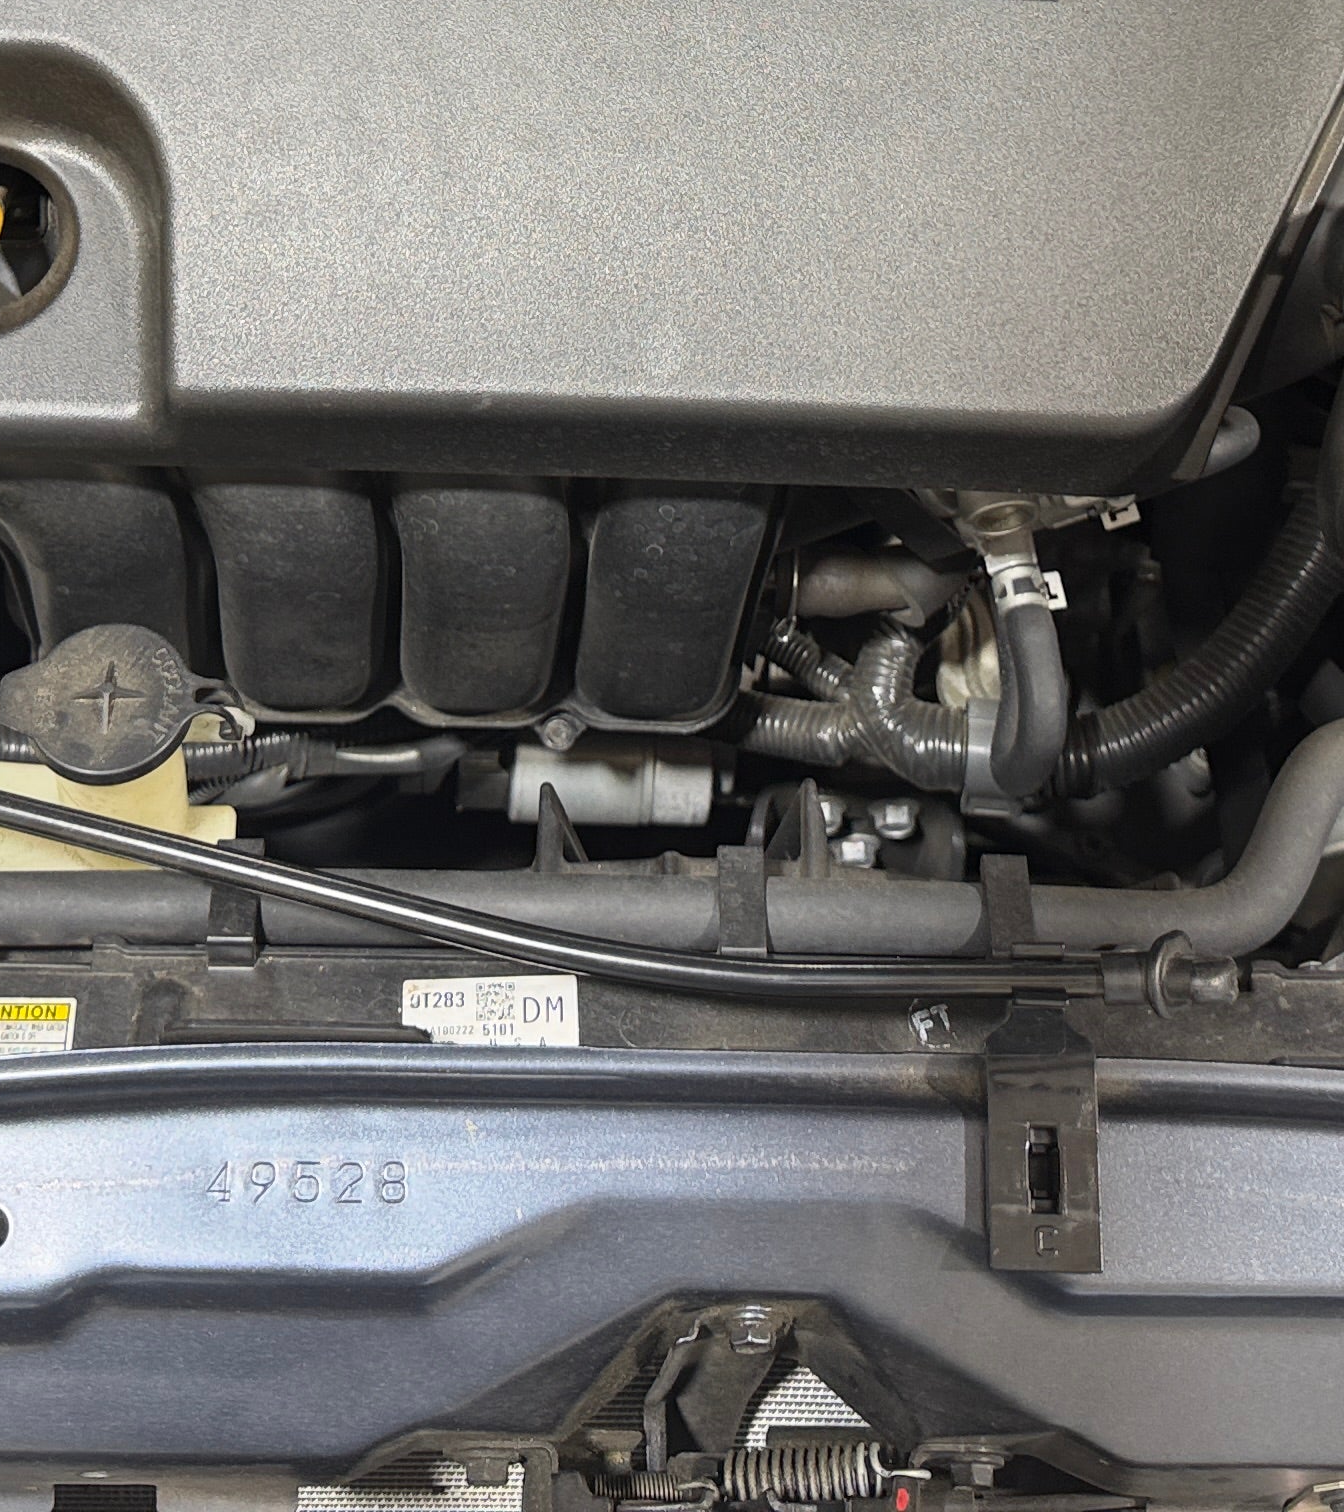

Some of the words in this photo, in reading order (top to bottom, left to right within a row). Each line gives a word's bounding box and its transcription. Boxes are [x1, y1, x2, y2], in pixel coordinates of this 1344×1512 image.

[522, 995, 564, 1024] DM
[482, 1023, 515, 1037] 5101
[204, 1159, 410, 1205] 49528
